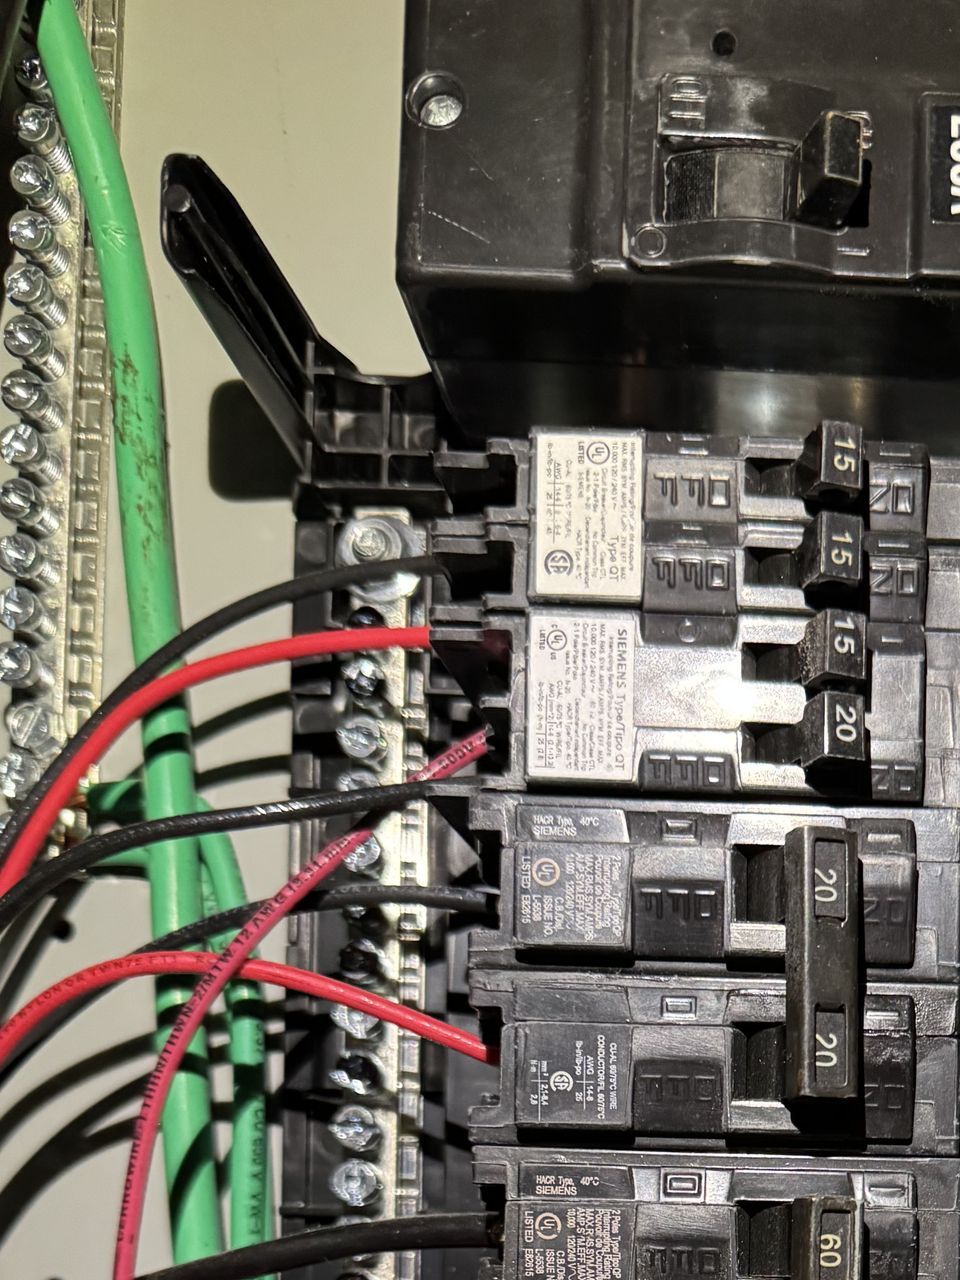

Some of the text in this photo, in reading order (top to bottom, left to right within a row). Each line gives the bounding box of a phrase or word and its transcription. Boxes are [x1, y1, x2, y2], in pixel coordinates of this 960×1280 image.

[833, 436, 855, 473] 15
[831, 530, 852, 568] 15
[833, 617, 856, 655] 15
[616, 628, 627, 689] SIEMENS
[834, 704, 857, 743] 20
[814, 868, 838, 903] 20
[814, 1033, 838, 1069] 20
[535, 1185, 578, 1196] SIEMENS
[524, 1210, 534, 1243] LISTED
[820, 1233, 842, 1269] 60
